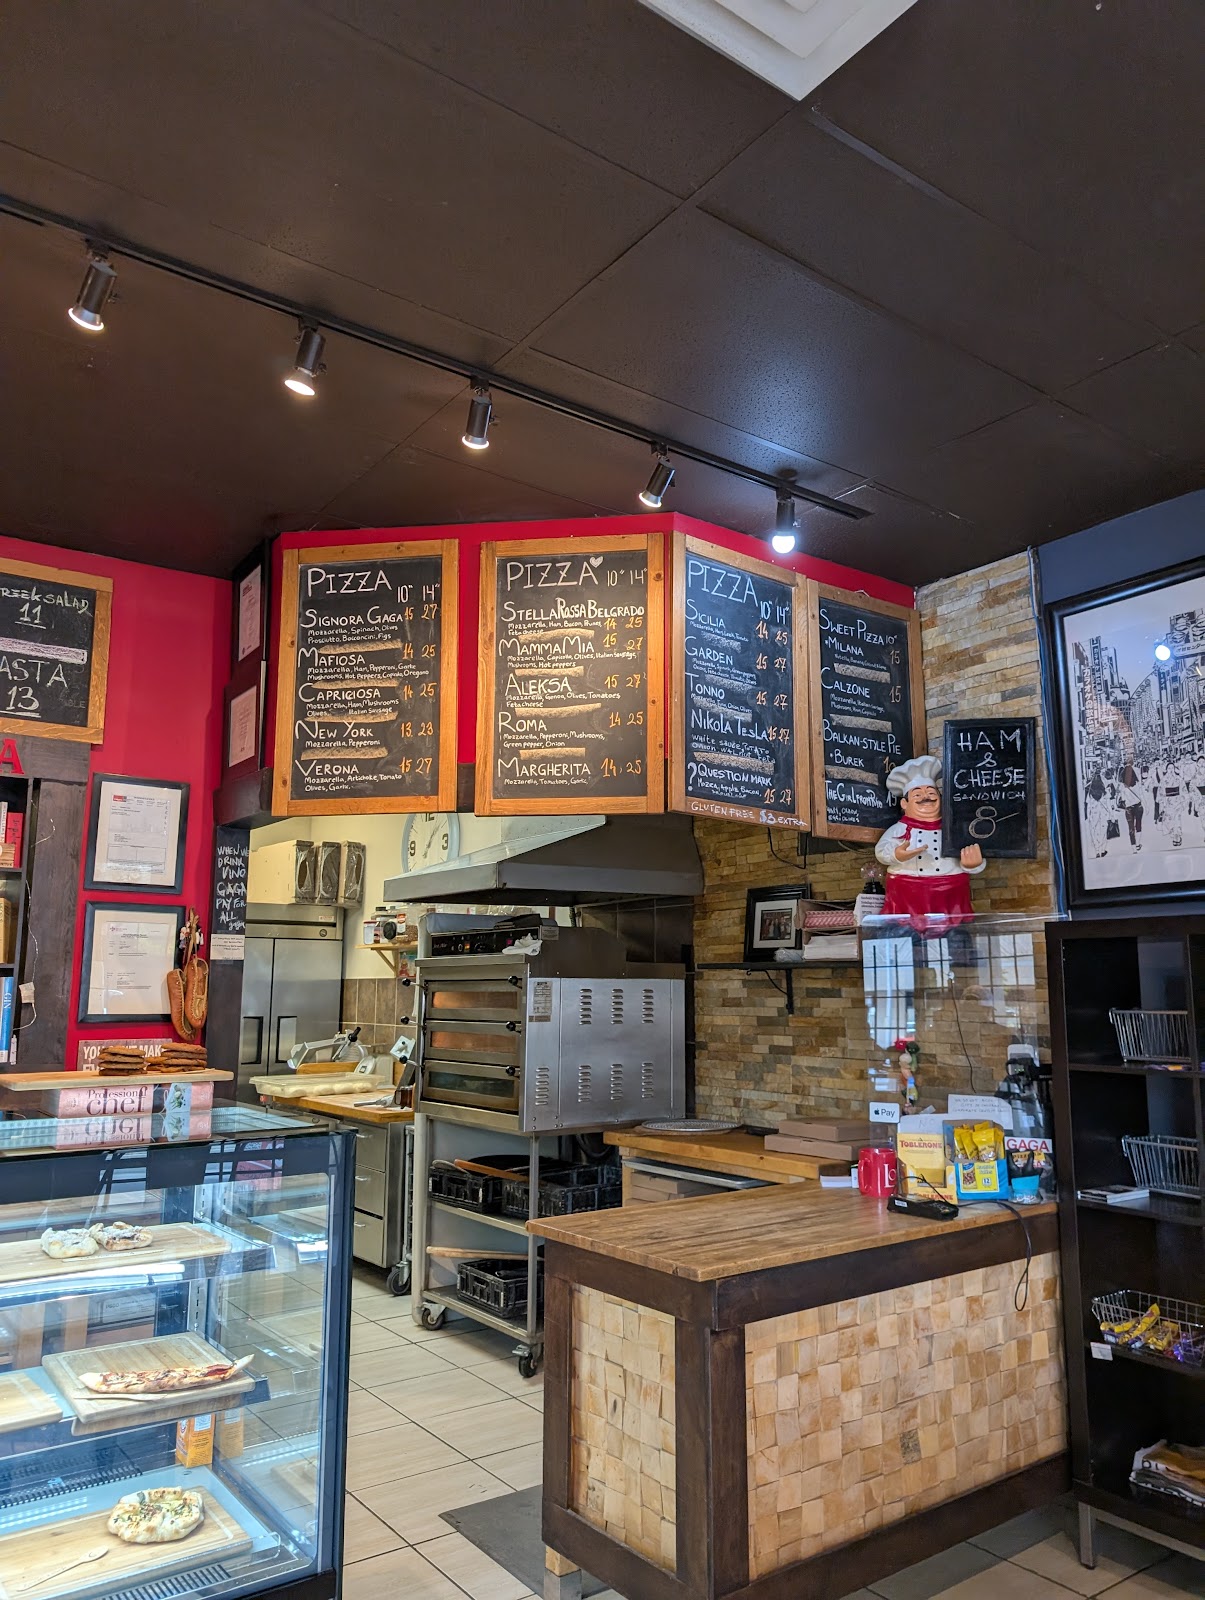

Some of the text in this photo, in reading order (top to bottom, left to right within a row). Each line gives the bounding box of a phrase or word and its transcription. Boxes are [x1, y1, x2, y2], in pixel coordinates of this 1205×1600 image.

[308, 568, 392, 597] PIZZA
[507, 562, 598, 591] PIZZA
[688, 560, 758, 607] PIZZA
[0, 587, 41, 602] REEK
[19, 602, 41, 624] 11
[300, 604, 437, 628] SIGNORA GAGA 15 27
[501, 601, 558, 622] STELLA
[587, 600, 644, 618] BELGRADO
[604, 617, 643, 630] 14 25
[685, 599, 725, 629] SICILIA
[756, 621, 768, 639] 14
[775, 631, 788, 645] 25
[819, 609, 855, 636] SWEET
[857, 620, 884, 645] PIZZA
[499, 633, 643, 656] MAMMA MIA 15 27
[685, 636, 733, 665] GARDEN
[756, 653, 767, 669] 15
[774, 658, 786, 672] 27
[298, 643, 436, 667] MAFIOSA 14 25
[890, 651, 900, 664] 15
[0, 655, 68, 688] ASTA
[404, 685, 413, 700] 14
[420, 683, 436, 697] 25
[505, 673, 572, 696] ALEKSA
[626, 674, 641, 688] 27
[685, 672, 725, 700] TONNO
[757, 691, 767, 705] 15
[774, 694, 788, 710] 27
[821, 667, 901, 703] CALZONE 15
[6, 686, 39, 710] 13
[295, 720, 337, 739] NEW
[343, 720, 373, 738] YORK
[418, 722, 433, 736] 23
[499, 712, 643, 733] ROMA 14 25
[767, 726, 776, 740] 15
[823, 719, 901, 754] BALKAN-STYLE PIE
[957, 728, 1021, 752] HAM
[295, 757, 432, 776] VERONA 15 27
[498, 757, 641, 777] MARGHERITA 14 25
[834, 749, 864, 767] BUREK
[976, 752, 997, 768] &
[698, 763, 749, 781] QUESTION
[954, 767, 1025, 789] CHEESE
[764, 789, 776, 804] 15
[780, 789, 791, 805] 27
[953, 791, 1026, 801] SANDWICH
[691, 802, 727, 815] GLUTEN
[729, 809, 755, 818] FREE
[778, 817, 807, 826] EXTRA
[218, 844, 239, 855] WHEN
[410, 840, 416, 856] 9
[442, 833, 448, 851] 3
[218, 856, 245, 868] DRINK
[217, 882, 246, 896] GAGA
[216, 897, 232, 910] PAY
[4, 992, 12, 1009] GIN
[86, 1086, 148, 1115] chef
[881, 1109, 895, 1118] Pay
[900, 1140, 942, 1148] TOBLERONE
[1007, 1138, 1050, 1152] GAGA
